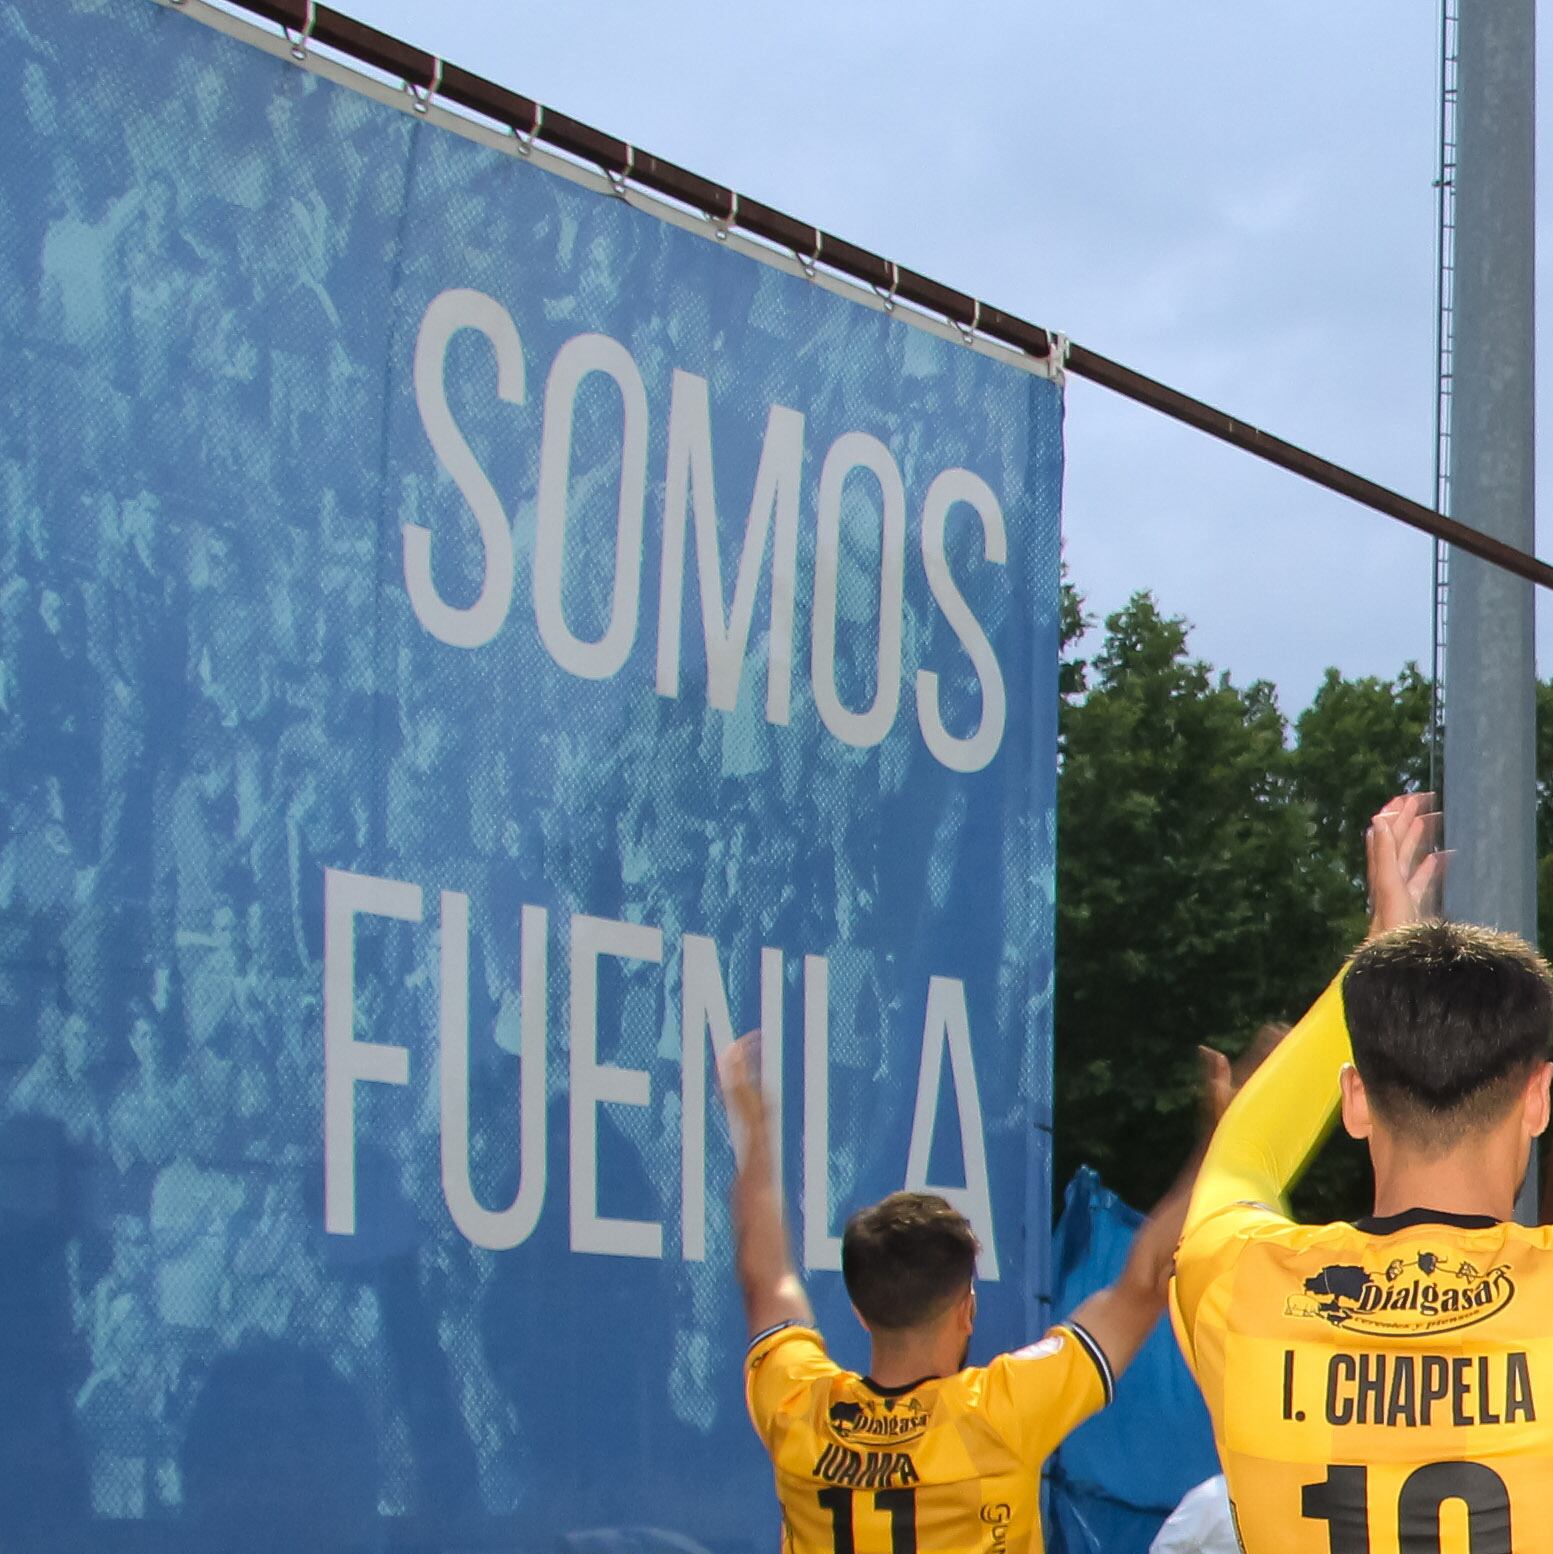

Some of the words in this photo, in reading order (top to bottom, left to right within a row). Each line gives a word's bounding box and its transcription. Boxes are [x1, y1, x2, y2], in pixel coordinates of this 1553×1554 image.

[403, 288, 1006, 773] SOMOS
[323, 866, 1000, 1283] FUENLA
[1282, 1350, 1307, 1422] I.
[1326, 1351, 1537, 1428] CHAPELA
[1358, 1279, 1496, 1316] Dialgasa
